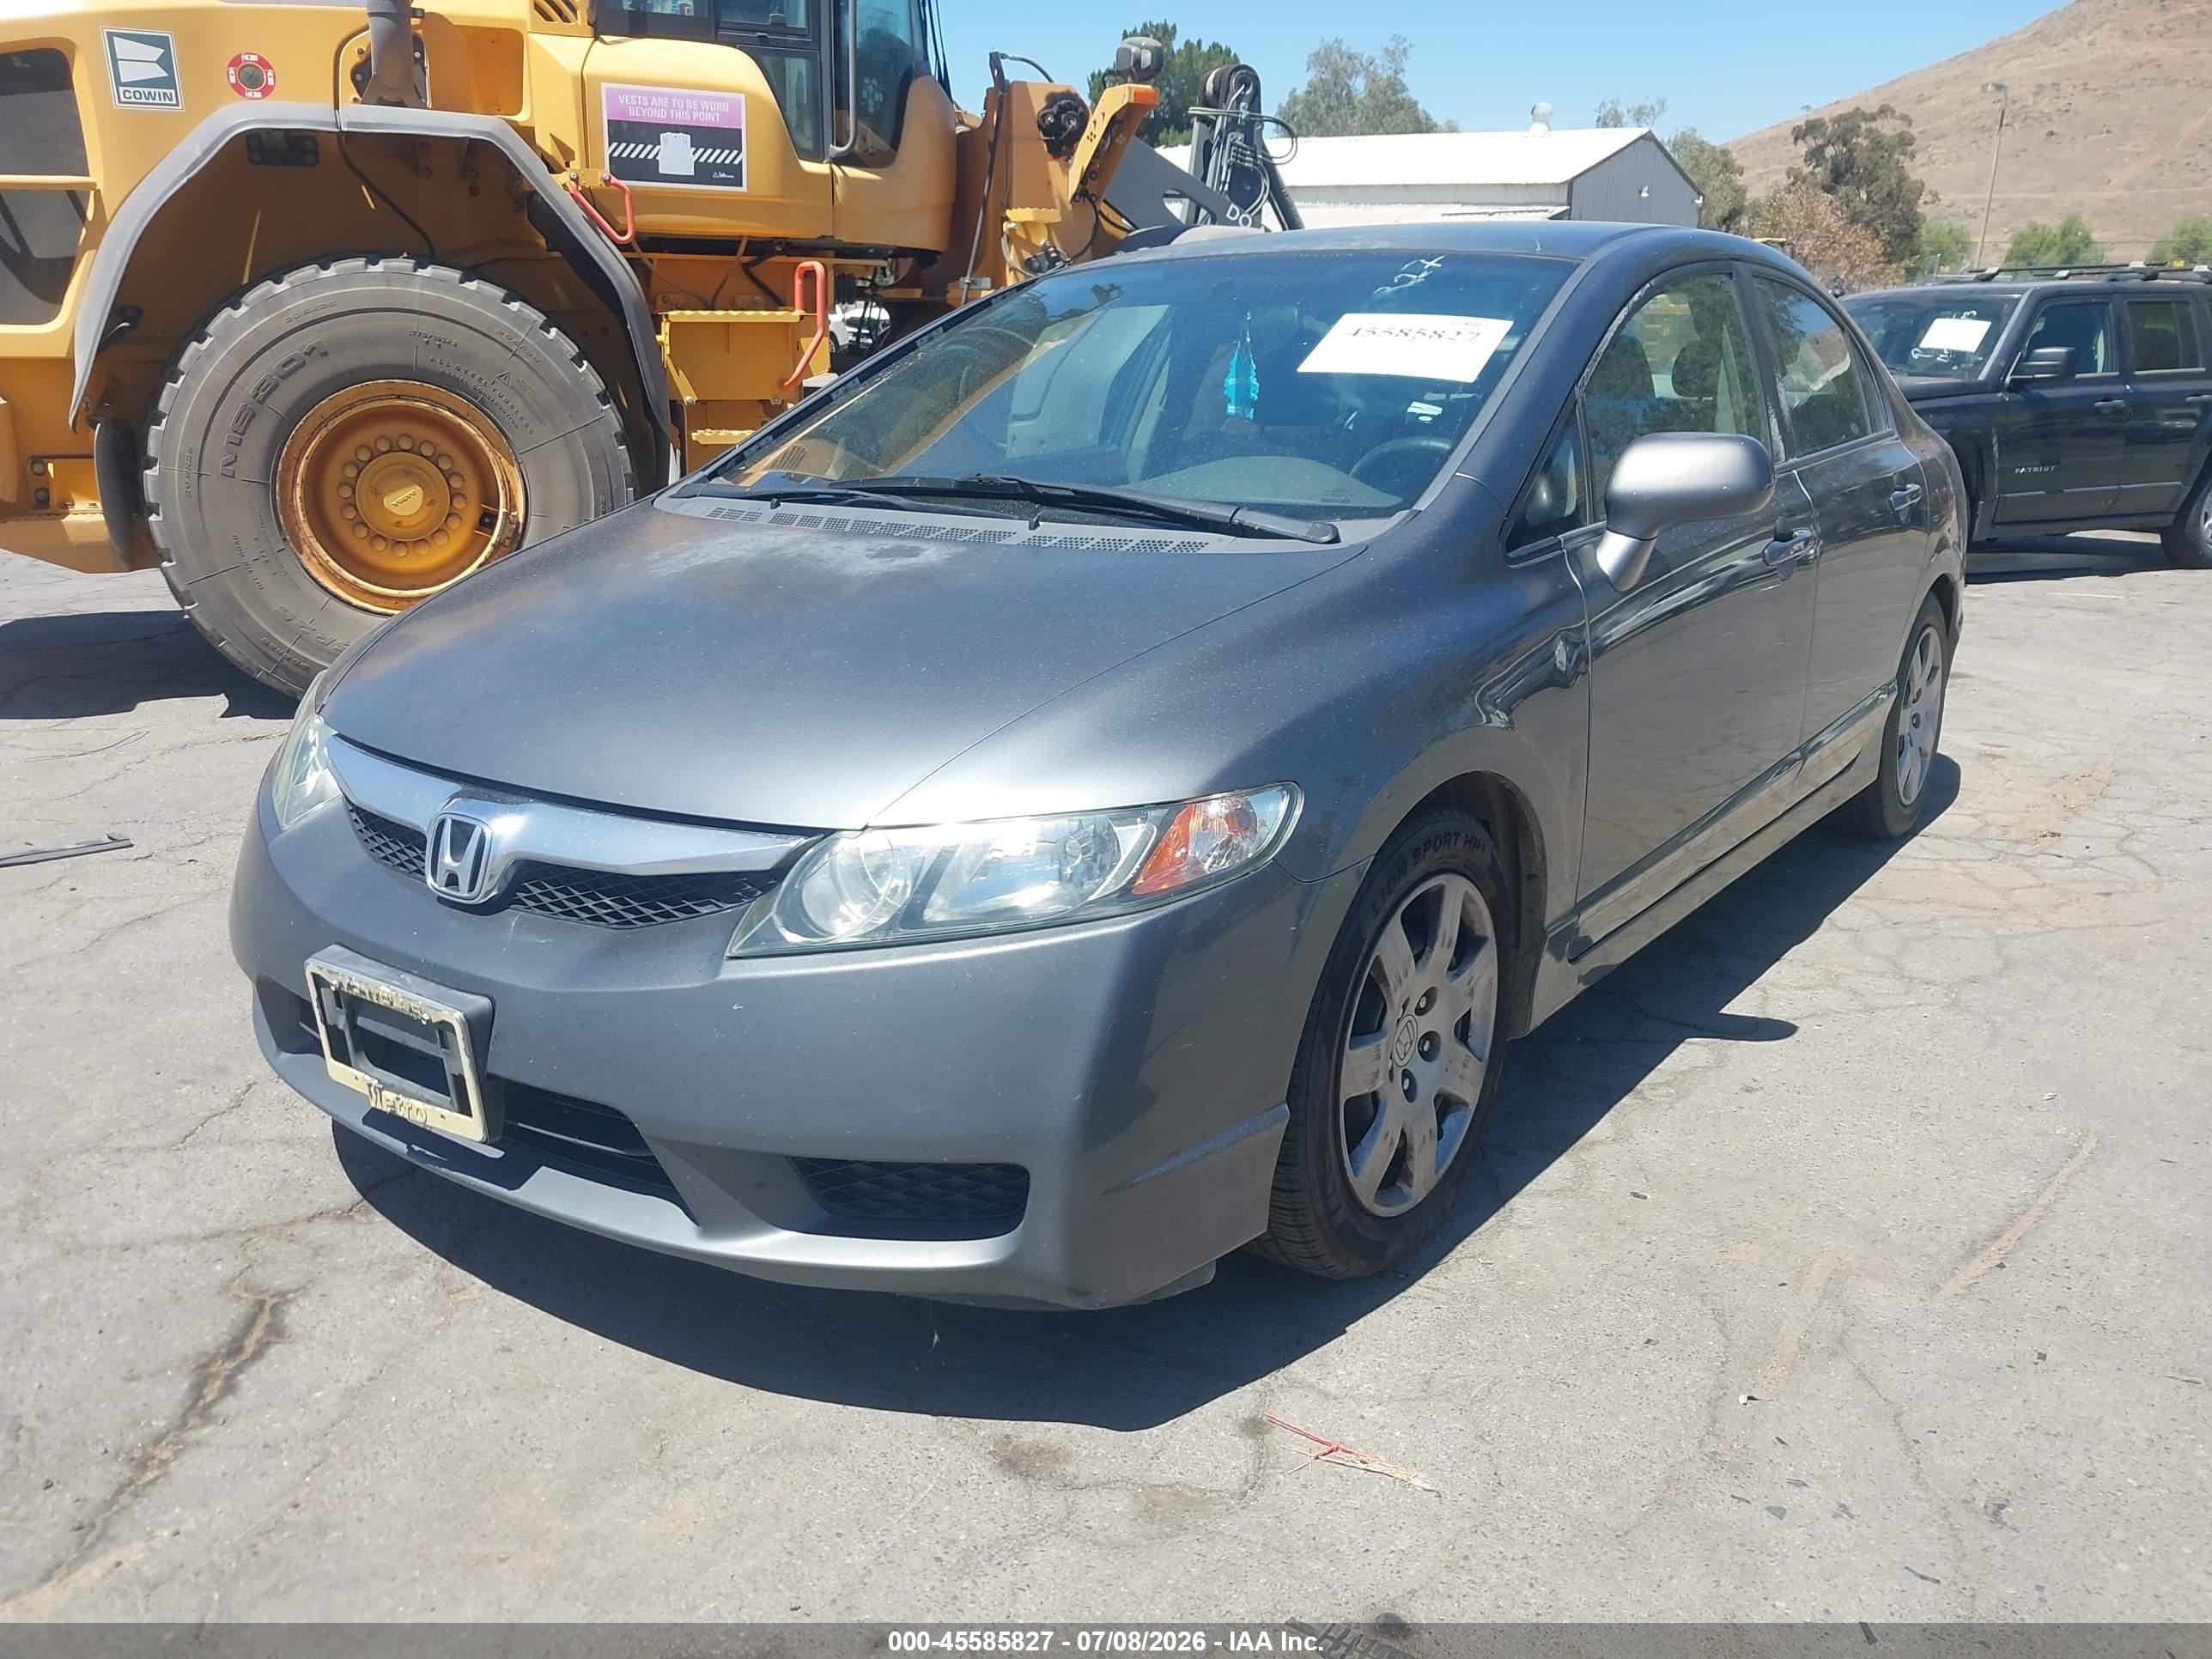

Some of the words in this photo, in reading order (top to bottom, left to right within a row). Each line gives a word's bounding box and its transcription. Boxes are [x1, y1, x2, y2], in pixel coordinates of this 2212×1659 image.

[123, 89, 173, 102] COWIN
[618, 94, 648, 105] VESTS
[651, 97, 671, 107] ARE
[672, 99, 684, 108] TO
[687, 100, 698, 109] BE
[700, 101, 730, 112] WORN
[629, 106, 667, 118] BEYOND
[670, 109, 690, 119] THIS
[693, 112, 721, 122] POINT
[2014, 465, 2057, 475] PATRIOT
